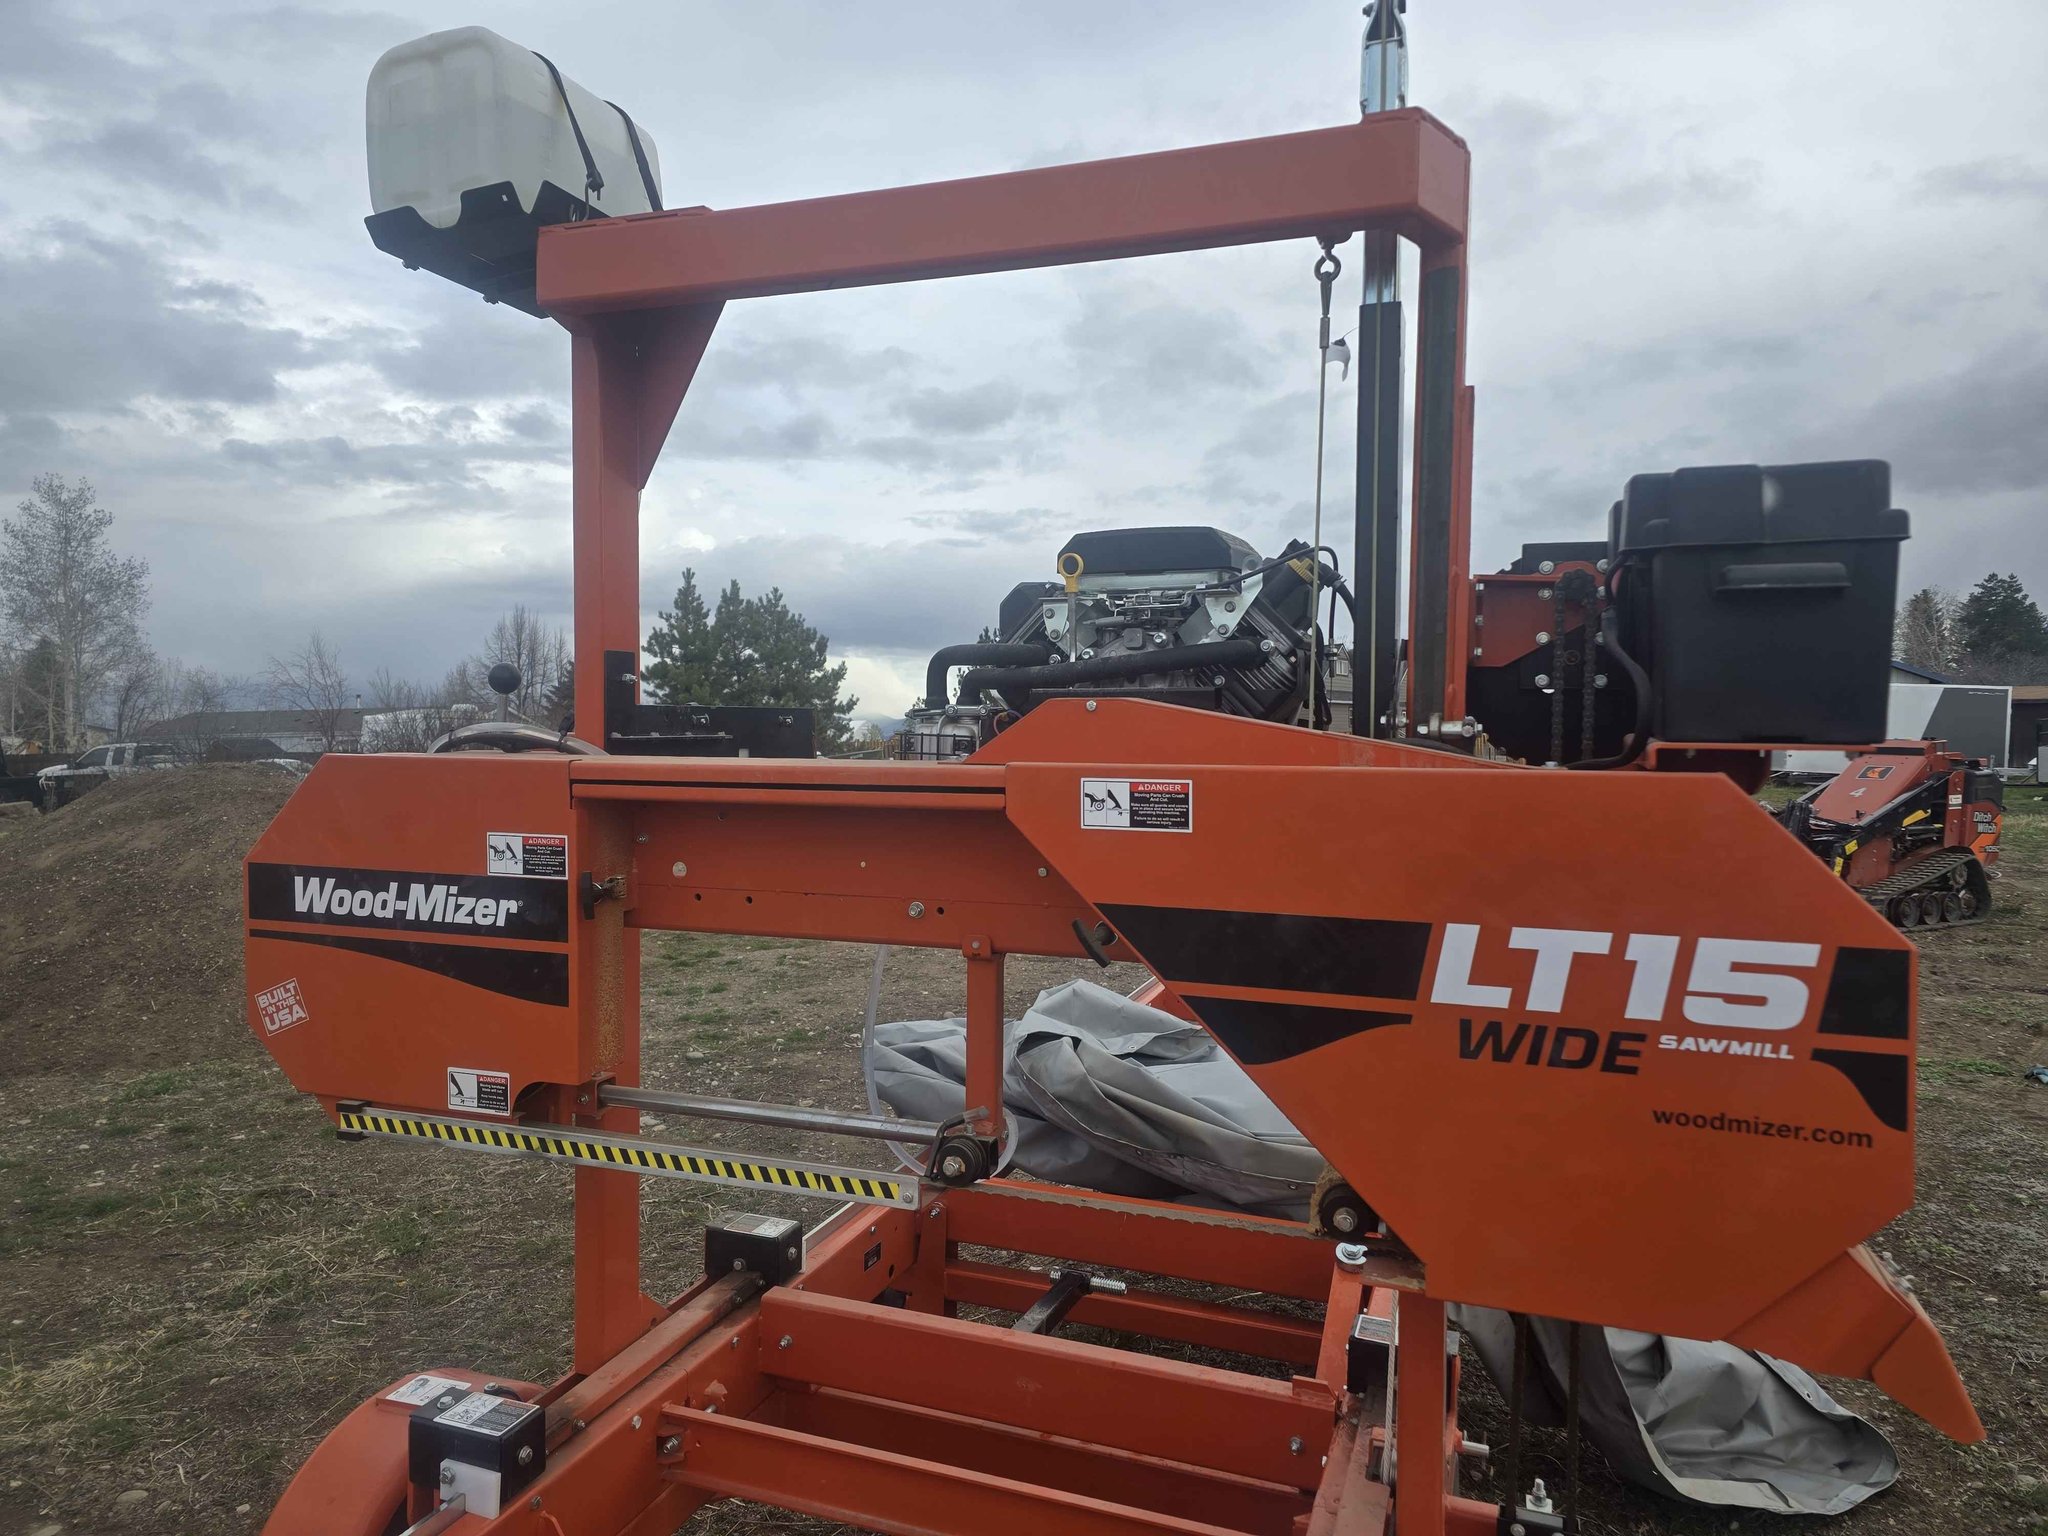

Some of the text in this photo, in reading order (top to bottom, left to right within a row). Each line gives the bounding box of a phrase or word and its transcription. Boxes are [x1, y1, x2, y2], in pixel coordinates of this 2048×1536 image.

[1848, 786, 1867, 798] 4
[1973, 811, 1992, 822] Ditch
[1978, 822, 1996, 833] Witch
[1430, 922, 1822, 1030] LT15
[258, 982, 296, 1008] BUILT
[266, 996, 296, 1014] IN THE
[264, 1004, 306, 1031] USA
[1459, 1018, 1795, 1075] WIDE SAWMILL
[1652, 1109, 1874, 1148] woodmizer.com
